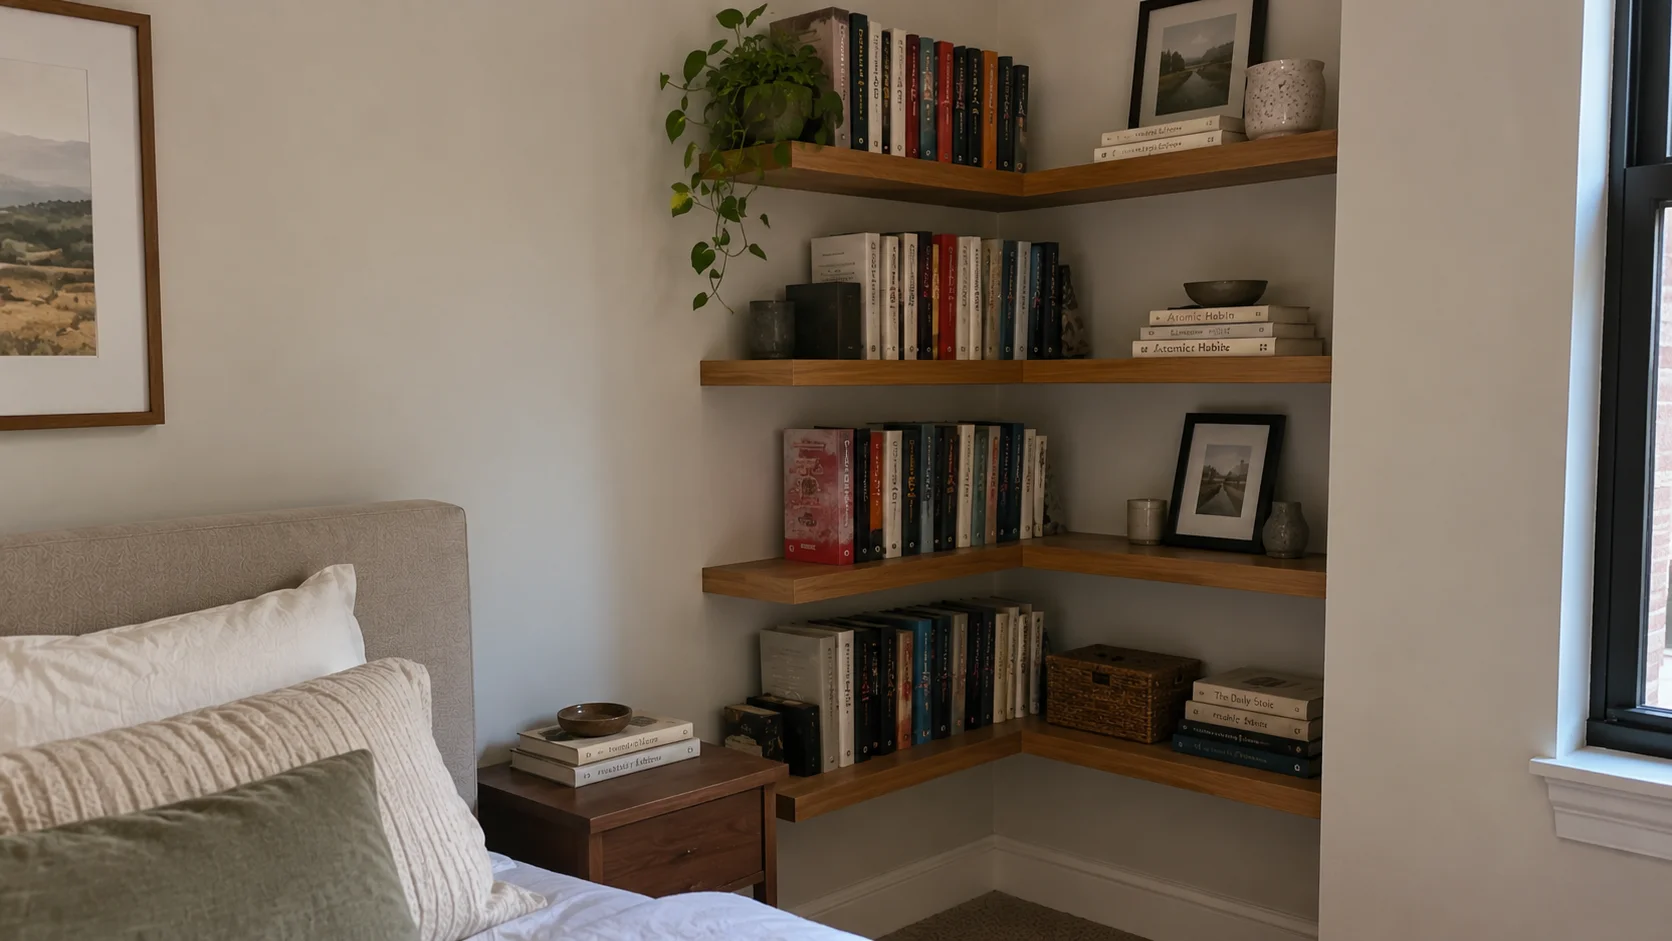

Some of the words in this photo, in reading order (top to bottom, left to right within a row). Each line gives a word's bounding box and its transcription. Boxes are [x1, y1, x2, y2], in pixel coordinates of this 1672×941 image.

[1214, 691, 1229, 701] The
[1231, 693, 1251, 707] Daily
[1254, 696, 1274, 709] Stoic
